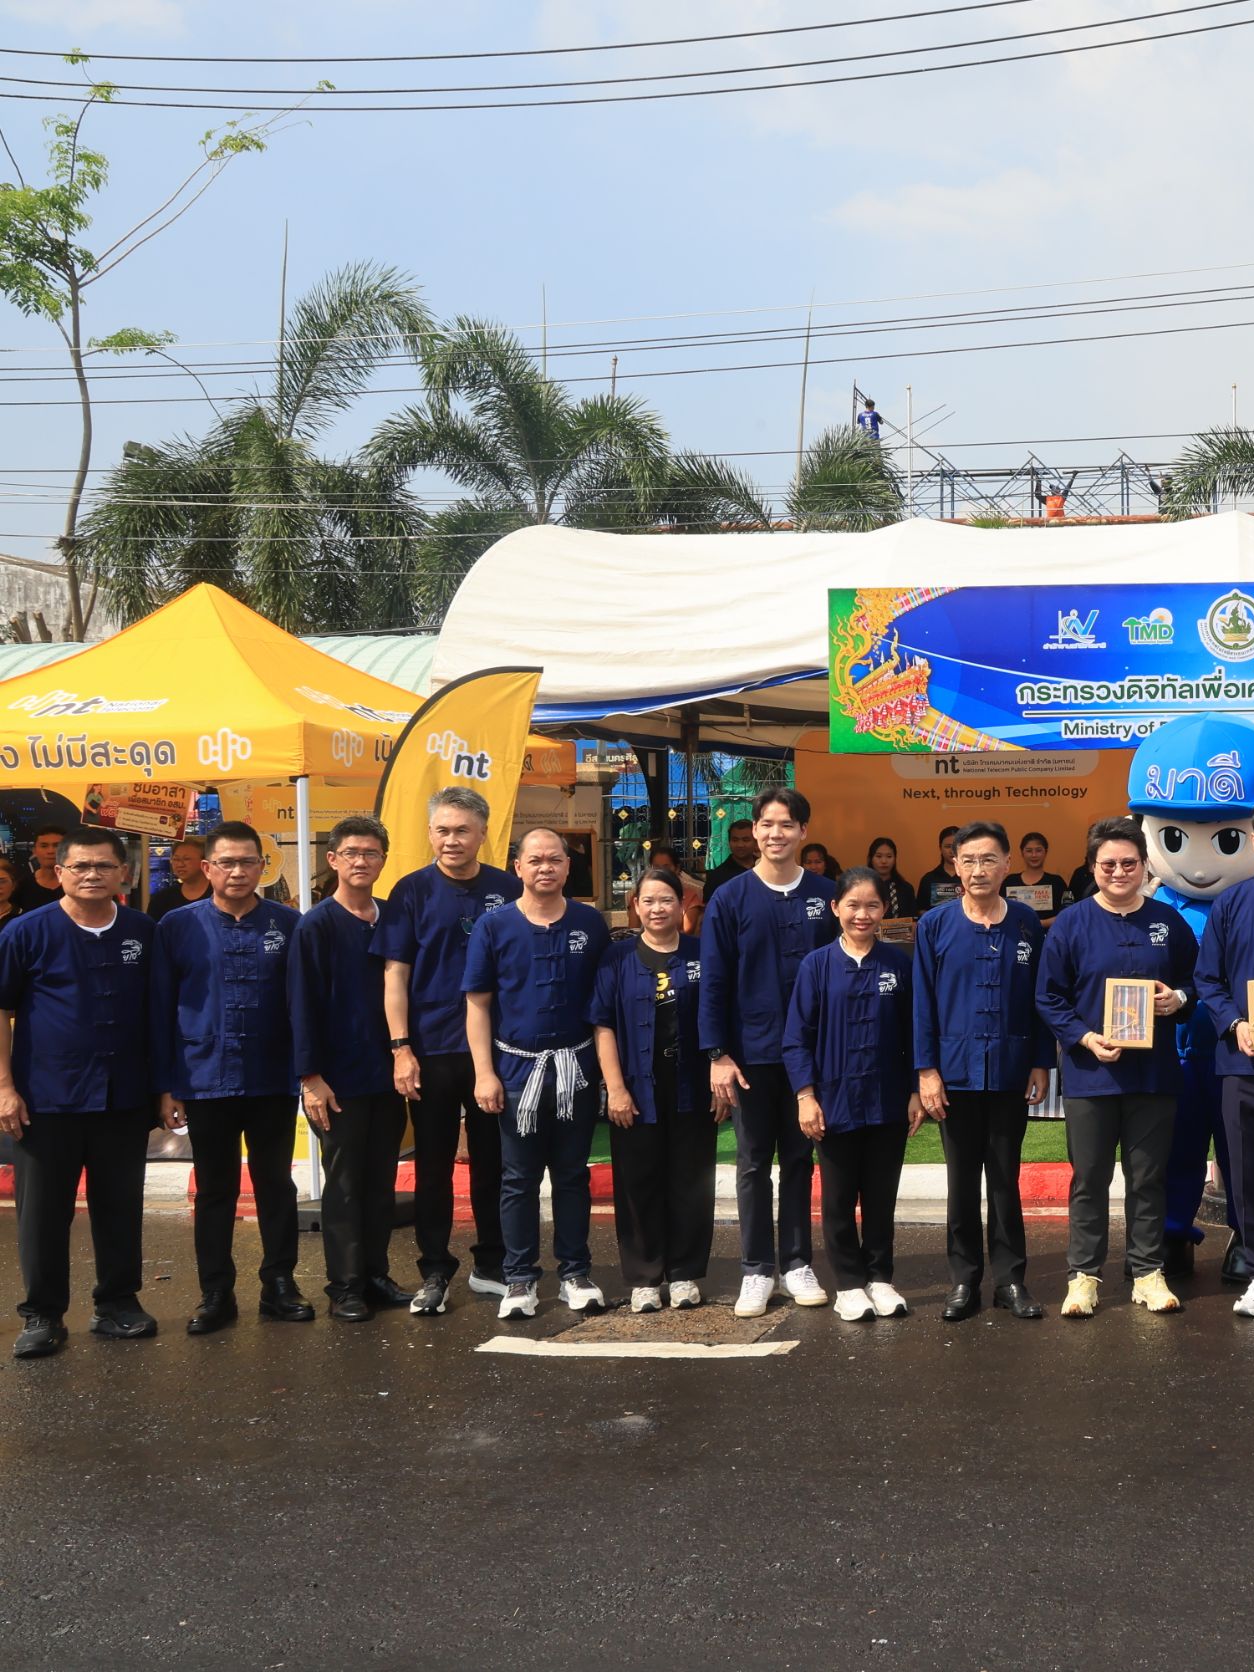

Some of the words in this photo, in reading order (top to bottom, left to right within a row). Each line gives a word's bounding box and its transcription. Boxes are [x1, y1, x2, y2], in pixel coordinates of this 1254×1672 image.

[1123, 617, 1174, 641] TMD
[1063, 721, 1132, 739] Ministry
[1137, 720, 1156, 735] of
[27, 733, 176, 777] ไม่มีสะดุด
[453, 752, 490, 779] nt
[935, 755, 960, 774] nt
[1145, 750, 1245, 802] มาดี
[903, 787, 941, 801] Next,
[944, 786, 1001, 801] through
[1005, 785, 1089, 800] Technology
[277, 805, 295, 820] nt
